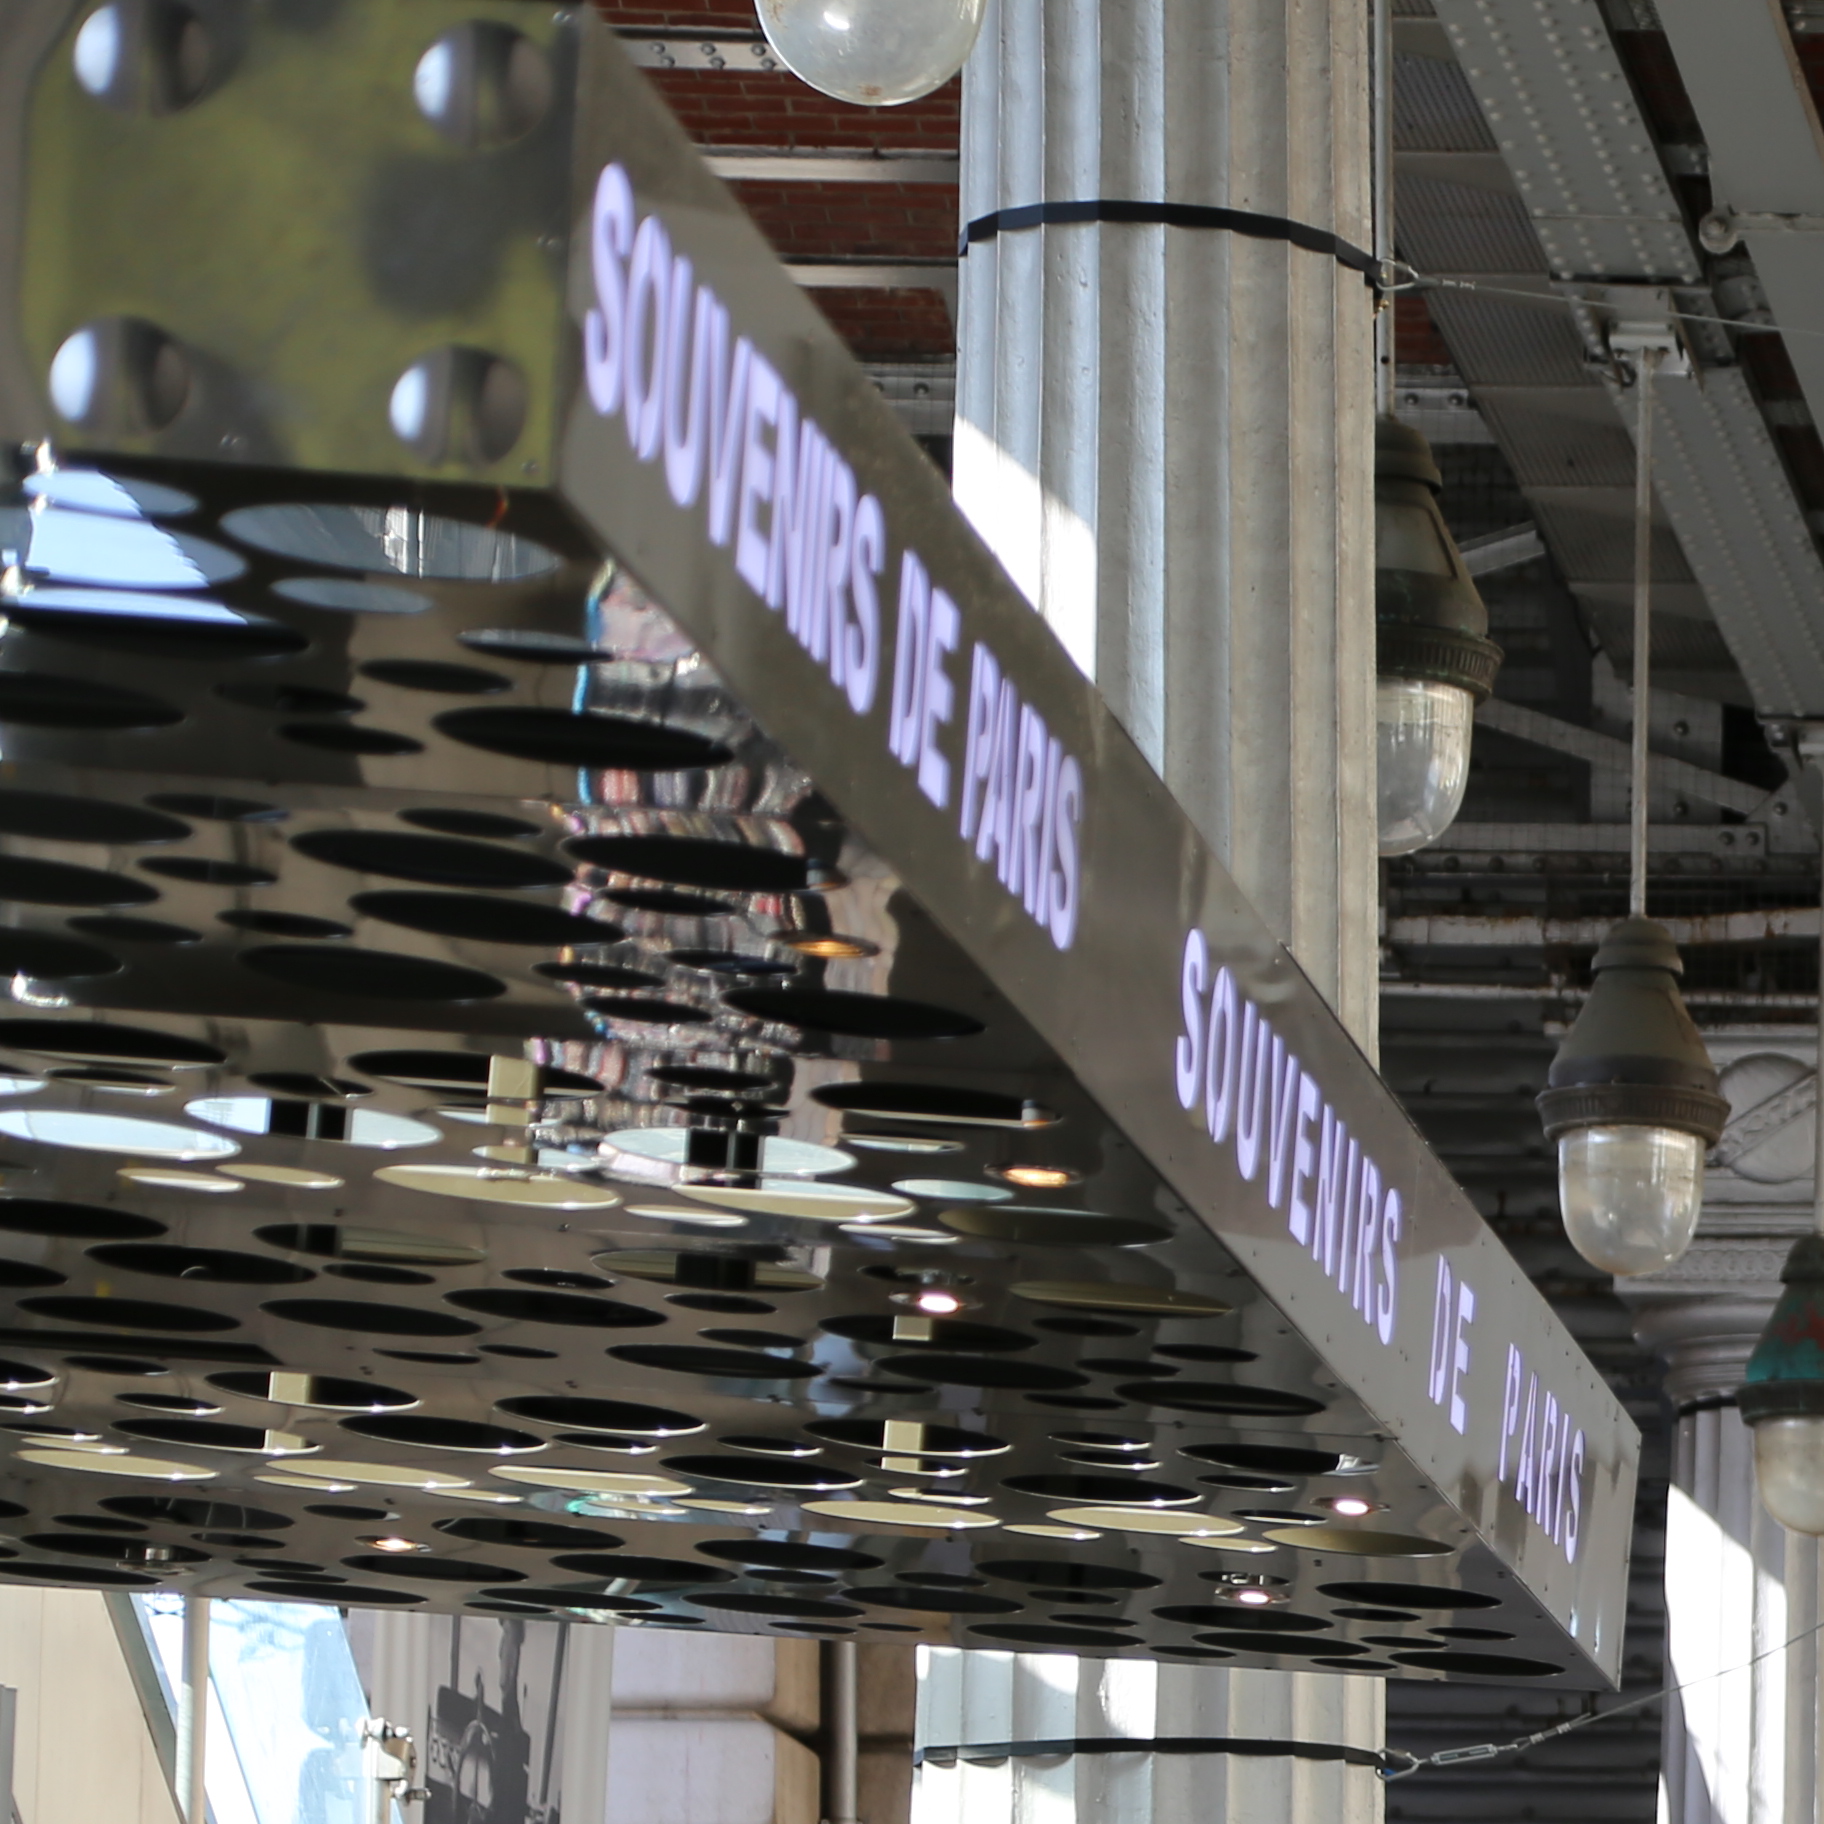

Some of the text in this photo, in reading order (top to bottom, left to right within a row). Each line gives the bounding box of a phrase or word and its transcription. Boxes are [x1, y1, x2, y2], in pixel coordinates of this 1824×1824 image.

[584, 161, 1085, 952] SOUVENIRS DE PARIS
[1175, 927, 1587, 1565] SOUVENIRS DE PARIS
